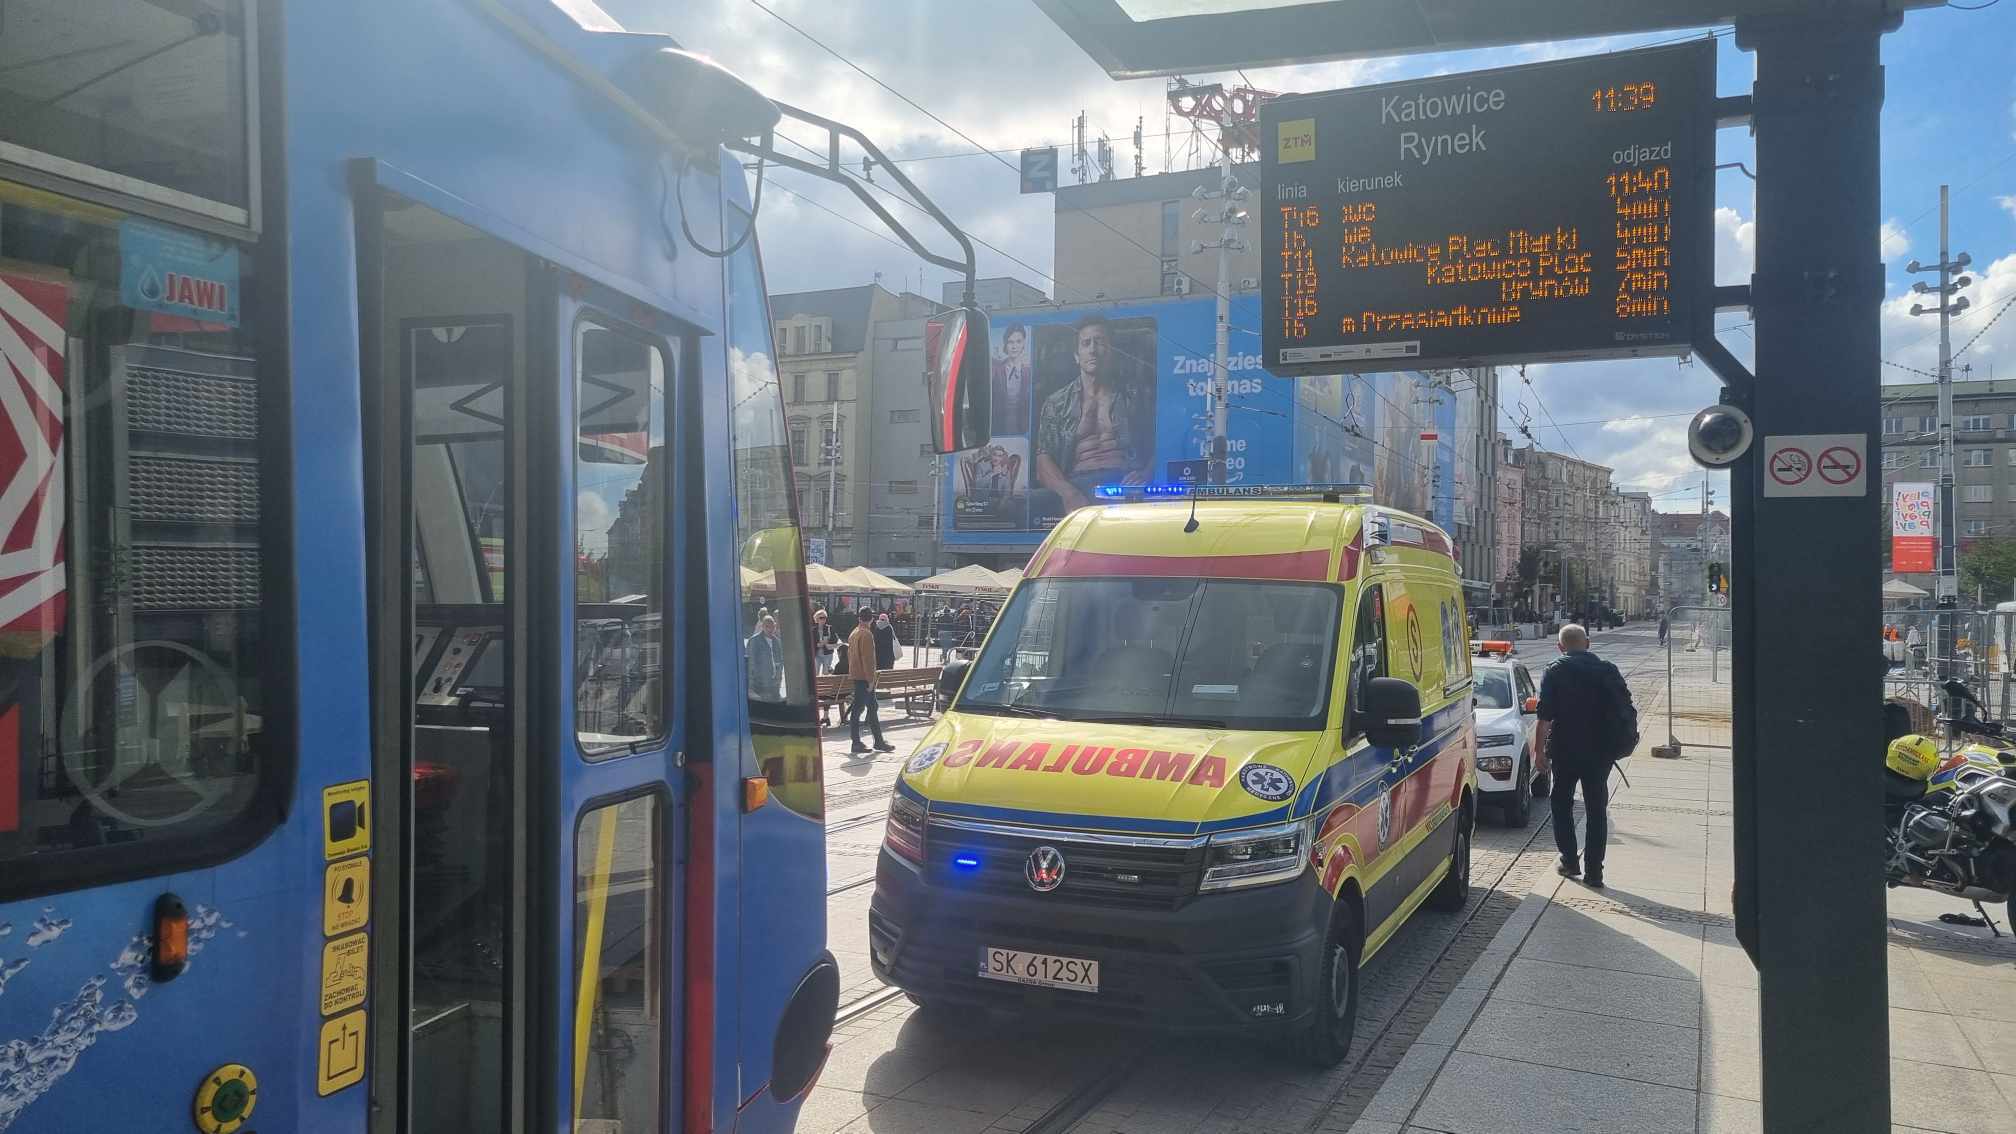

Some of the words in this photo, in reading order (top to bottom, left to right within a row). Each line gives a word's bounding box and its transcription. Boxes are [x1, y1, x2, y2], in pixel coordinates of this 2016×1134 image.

[1381, 86, 1505, 124] Katowice
[1592, 81, 1656, 112] 11:39
[1283, 134, 1312, 150] ZTM
[1400, 124, 1488, 165] Rynek
[1613, 141, 1671, 166] odjazd
[1278, 183, 1307, 200] linia
[1338, 171, 1402, 193] kierunek
[1342, 240, 1441, 268] Katowice
[1448, 234, 1500, 260] Plac
[165, 272, 227, 313] JAWI
[1227, 379, 1262, 394] nas
[993, 951, 1017, 975] SK
[1026, 956, 1092, 985] 612SX
